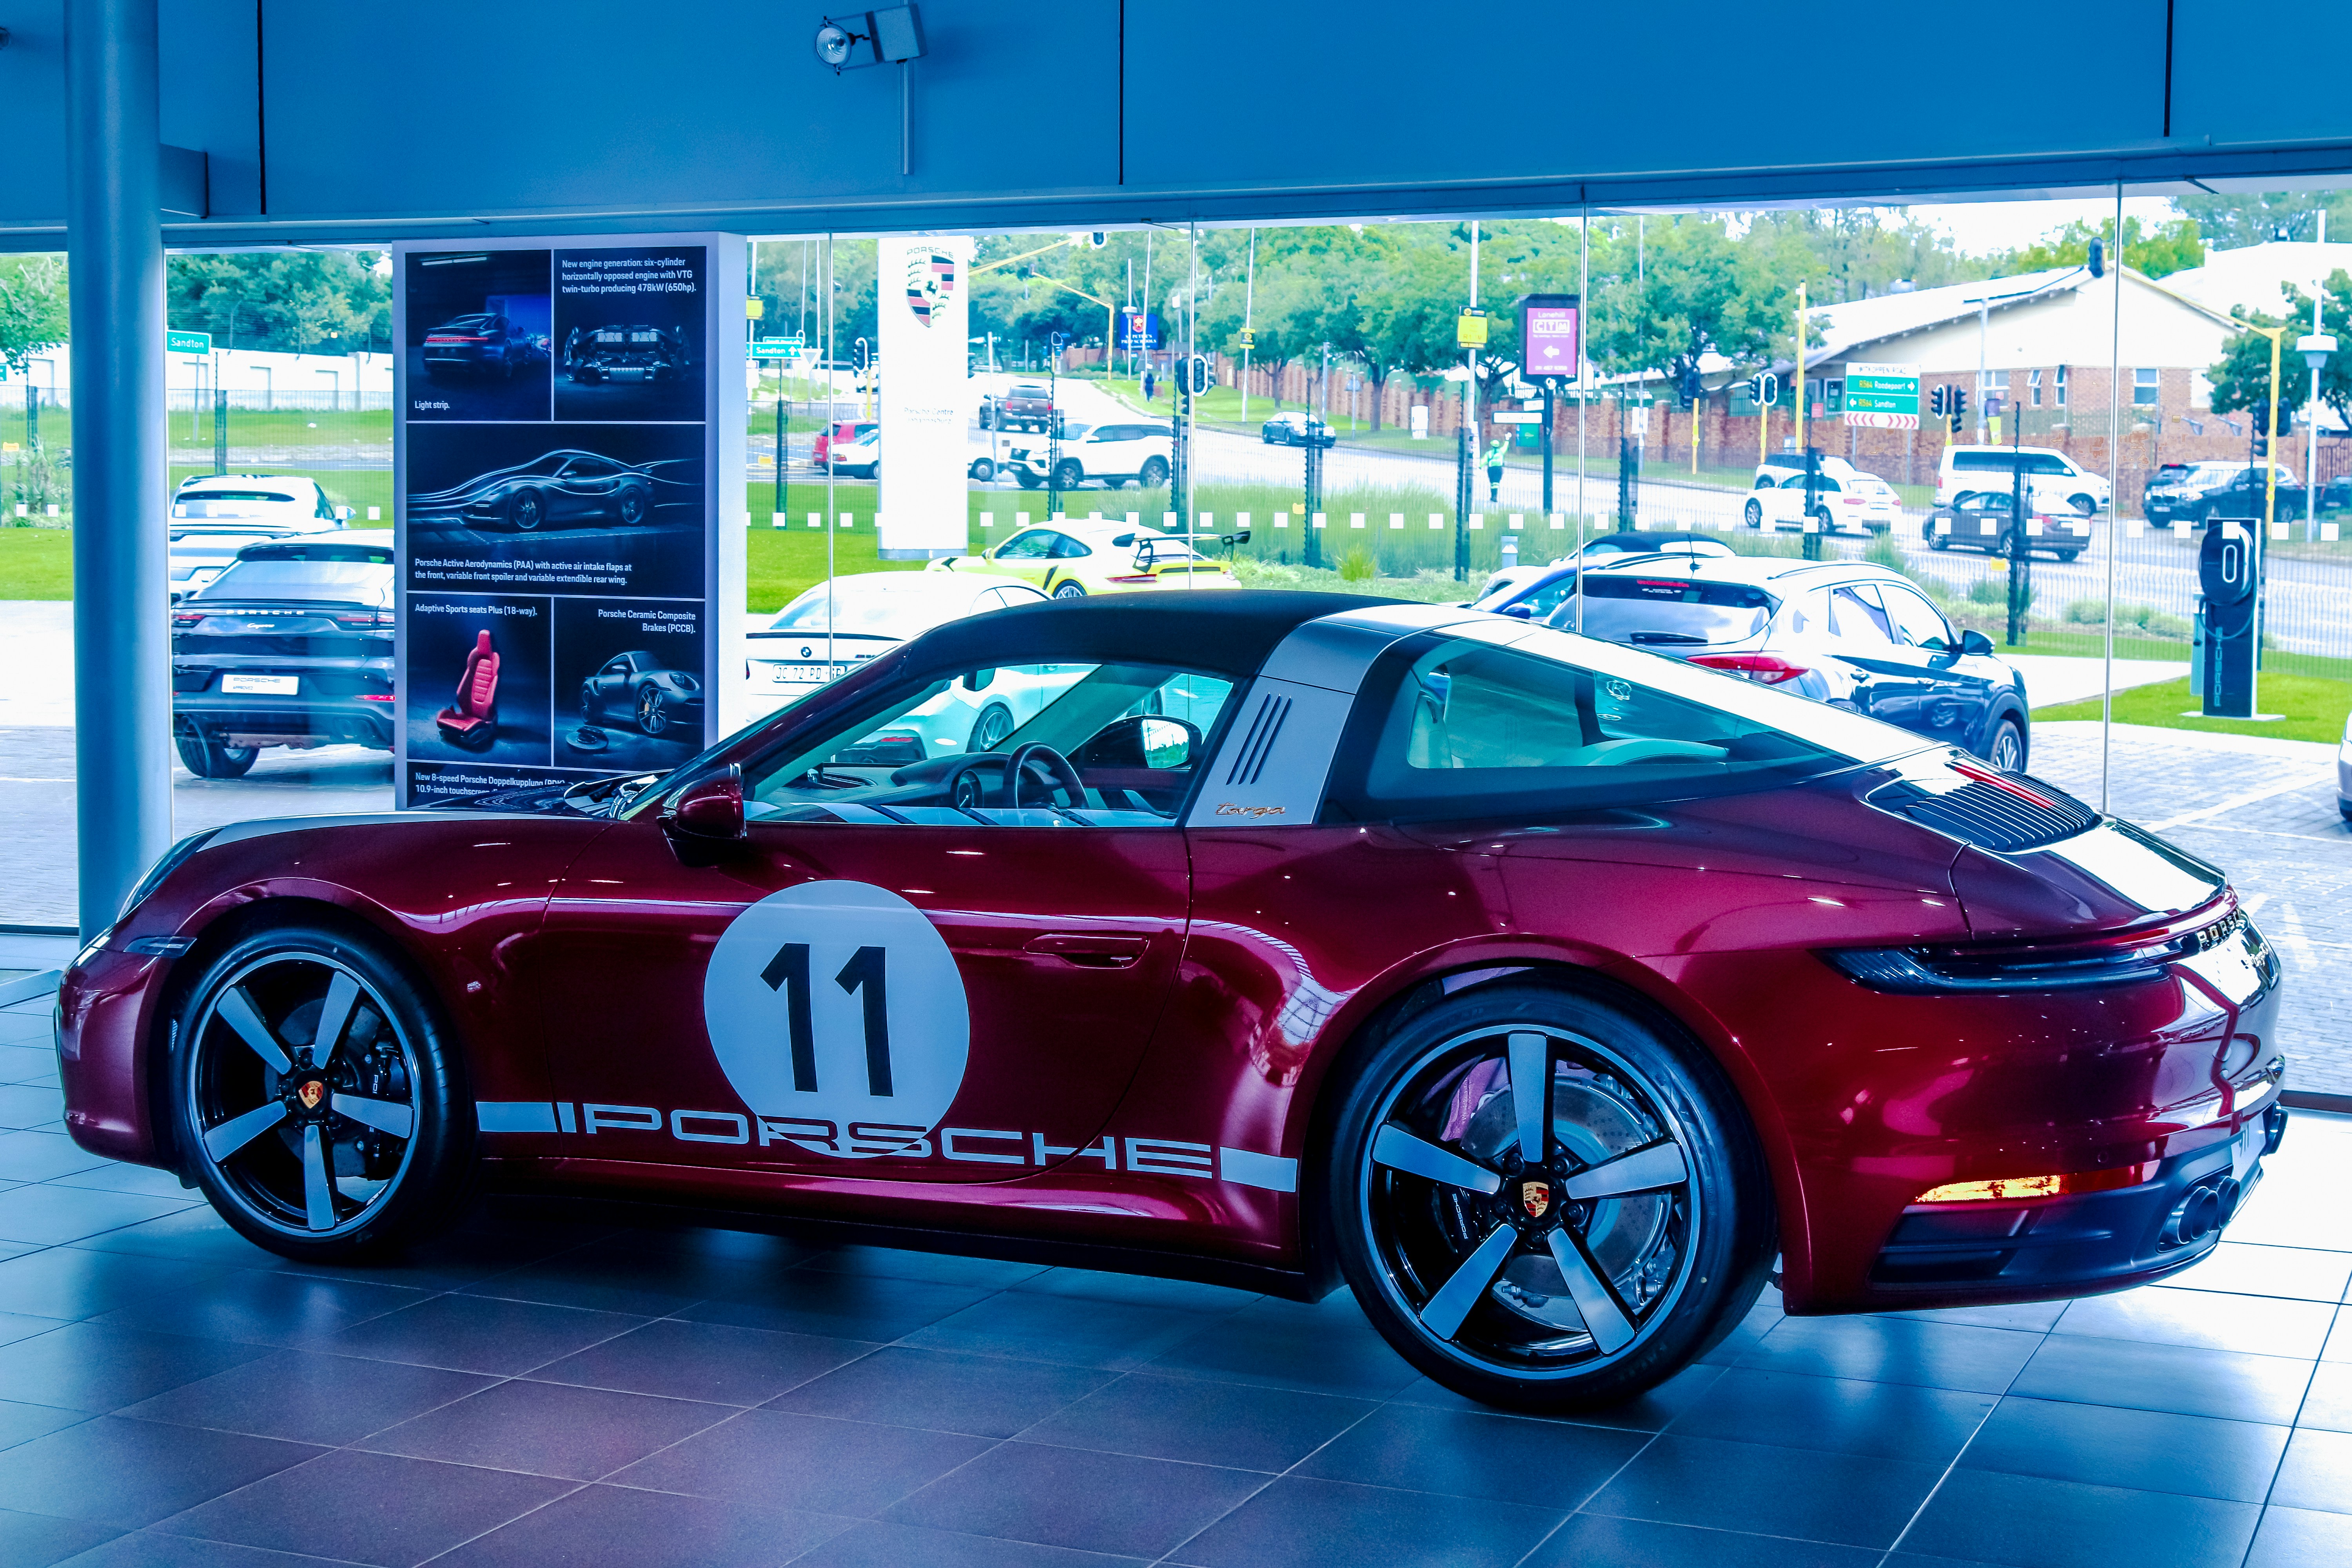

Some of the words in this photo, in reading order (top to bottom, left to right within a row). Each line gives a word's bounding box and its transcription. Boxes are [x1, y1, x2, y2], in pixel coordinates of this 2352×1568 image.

[907, 247, 954, 259] PORSCHE
[579, 260, 603, 269] engine
[603, 258, 643, 269] generation:
[644, 258, 686, 267] six-cylinder
[562, 272, 603, 281] horizontally
[604, 271, 634, 281] opposed
[635, 271, 658, 281] engine
[660, 270, 675, 279] with
[676, 270, 693, 279] VTG
[562, 285, 600, 293] twin-turbo
[601, 284, 636, 294] producing
[637, 283, 664, 292] 478kW
[665, 282, 696, 293] (650hp).
[170, 337, 204, 348] Sandton
[415, 400, 432, 410] Light
[433, 400, 450, 410] strip.
[1874, 399, 1896, 408] Sandton
[415, 558, 442, 566] Porsche
[443, 559, 464, 567] Active
[465, 559, 512, 570] Aerodynamics
[514, 560, 533, 570] (PAA)
[534, 561, 550, 569] with
[573, 562, 583, 570] air
[583, 562, 605, 570] intake
[606, 563, 623, 573] flaps
[427, 571, 445, 580] front,
[446, 571, 472, 580] variable
[473, 572, 490, 580] front
[491, 572, 514, 582] spoiler
[528, 573, 555, 582] variable
[556, 574, 592, 583] extendible
[608, 575, 627, 586] wing.
[415, 604, 445, 613] Adaptive
[445, 604, 468, 614] Sports
[488, 606, 503, 614] Plus
[504, 606, 538, 617] (18-way).
[598, 609, 626, 618] Porsche
[627, 610, 657, 619] Ceramic
[657, 611, 696, 621] Composite
[642, 623, 666, 632] Brakes
[668, 623, 696, 634] (PCCB).
[2214, 626, 2223, 707] PORSCHE
[776, 667, 787, 679] JC
[793, 667, 803, 679] 72
[810, 667, 822, 679] PD
[415, 772, 431, 780] New
[432, 773, 459, 784] 8-speed
[460, 775, 487, 784] Porsche
[415, 784, 448, 793] 10.9-inch
[759, 942, 893, 1097] 11
[582, 1103, 1213, 1179] PORSCHE
[1452, 1194, 1469, 1239] PORSCHE
